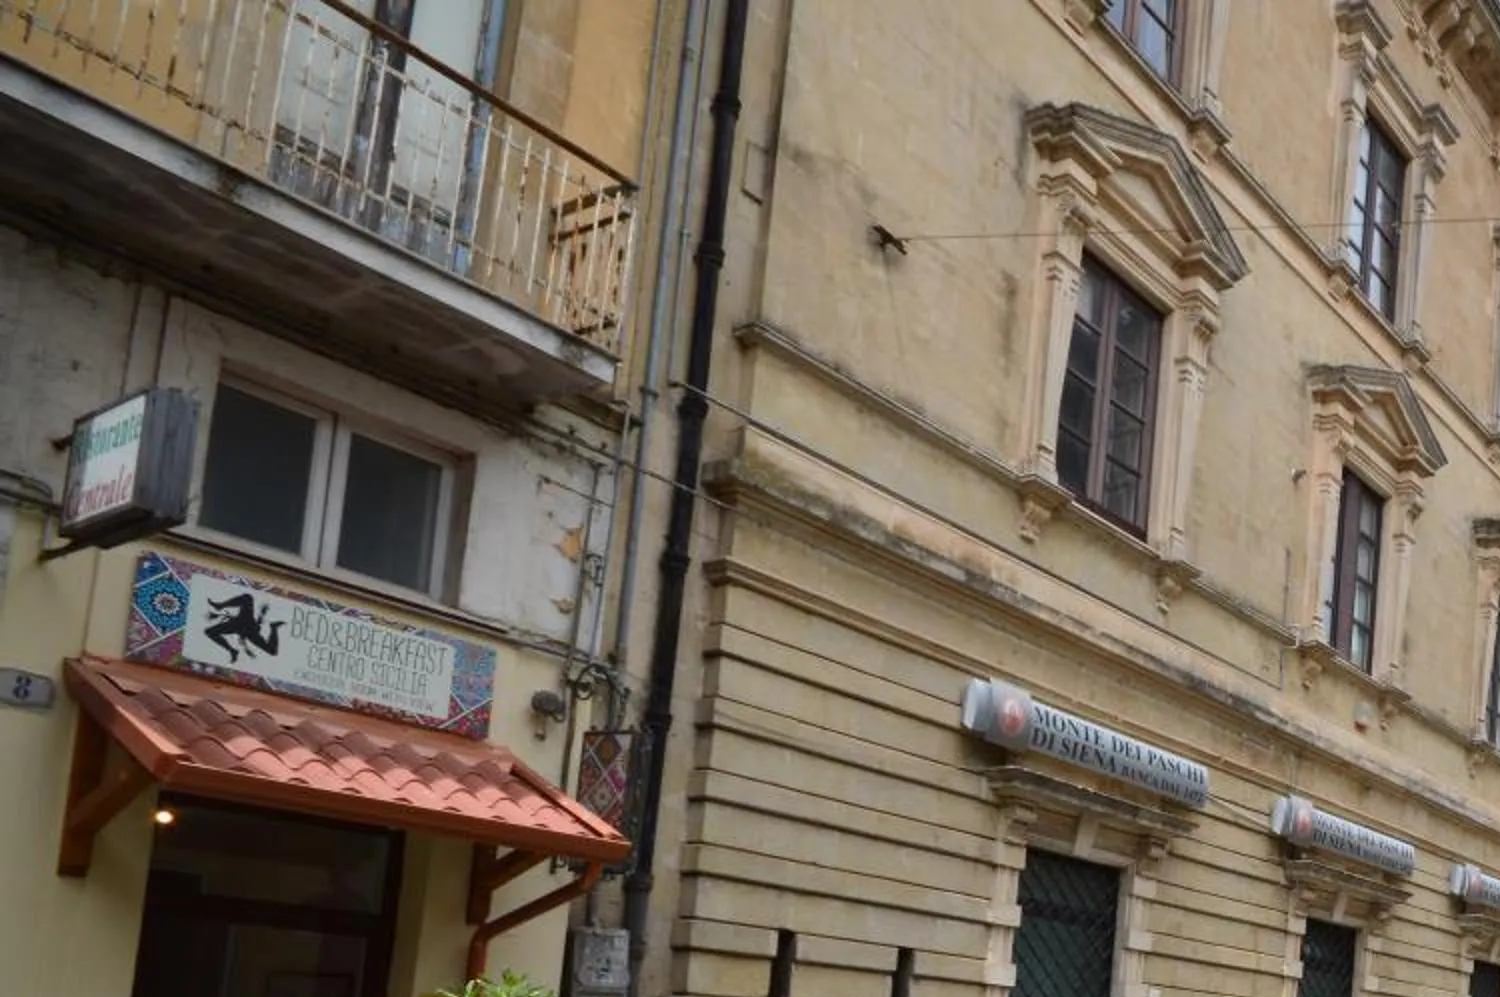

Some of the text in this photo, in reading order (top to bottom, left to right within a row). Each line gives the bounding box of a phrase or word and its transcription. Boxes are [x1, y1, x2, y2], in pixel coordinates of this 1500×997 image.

[13, 675, 32, 700] 8
[306, 645, 366, 681] CENTRO
[370, 661, 428, 699] SICILIA
[1030, 727, 1055, 751] DI
[1060, 738, 1116, 774] SIENA
[1032, 705, 1207, 785] MONTE DEI PASCHI
